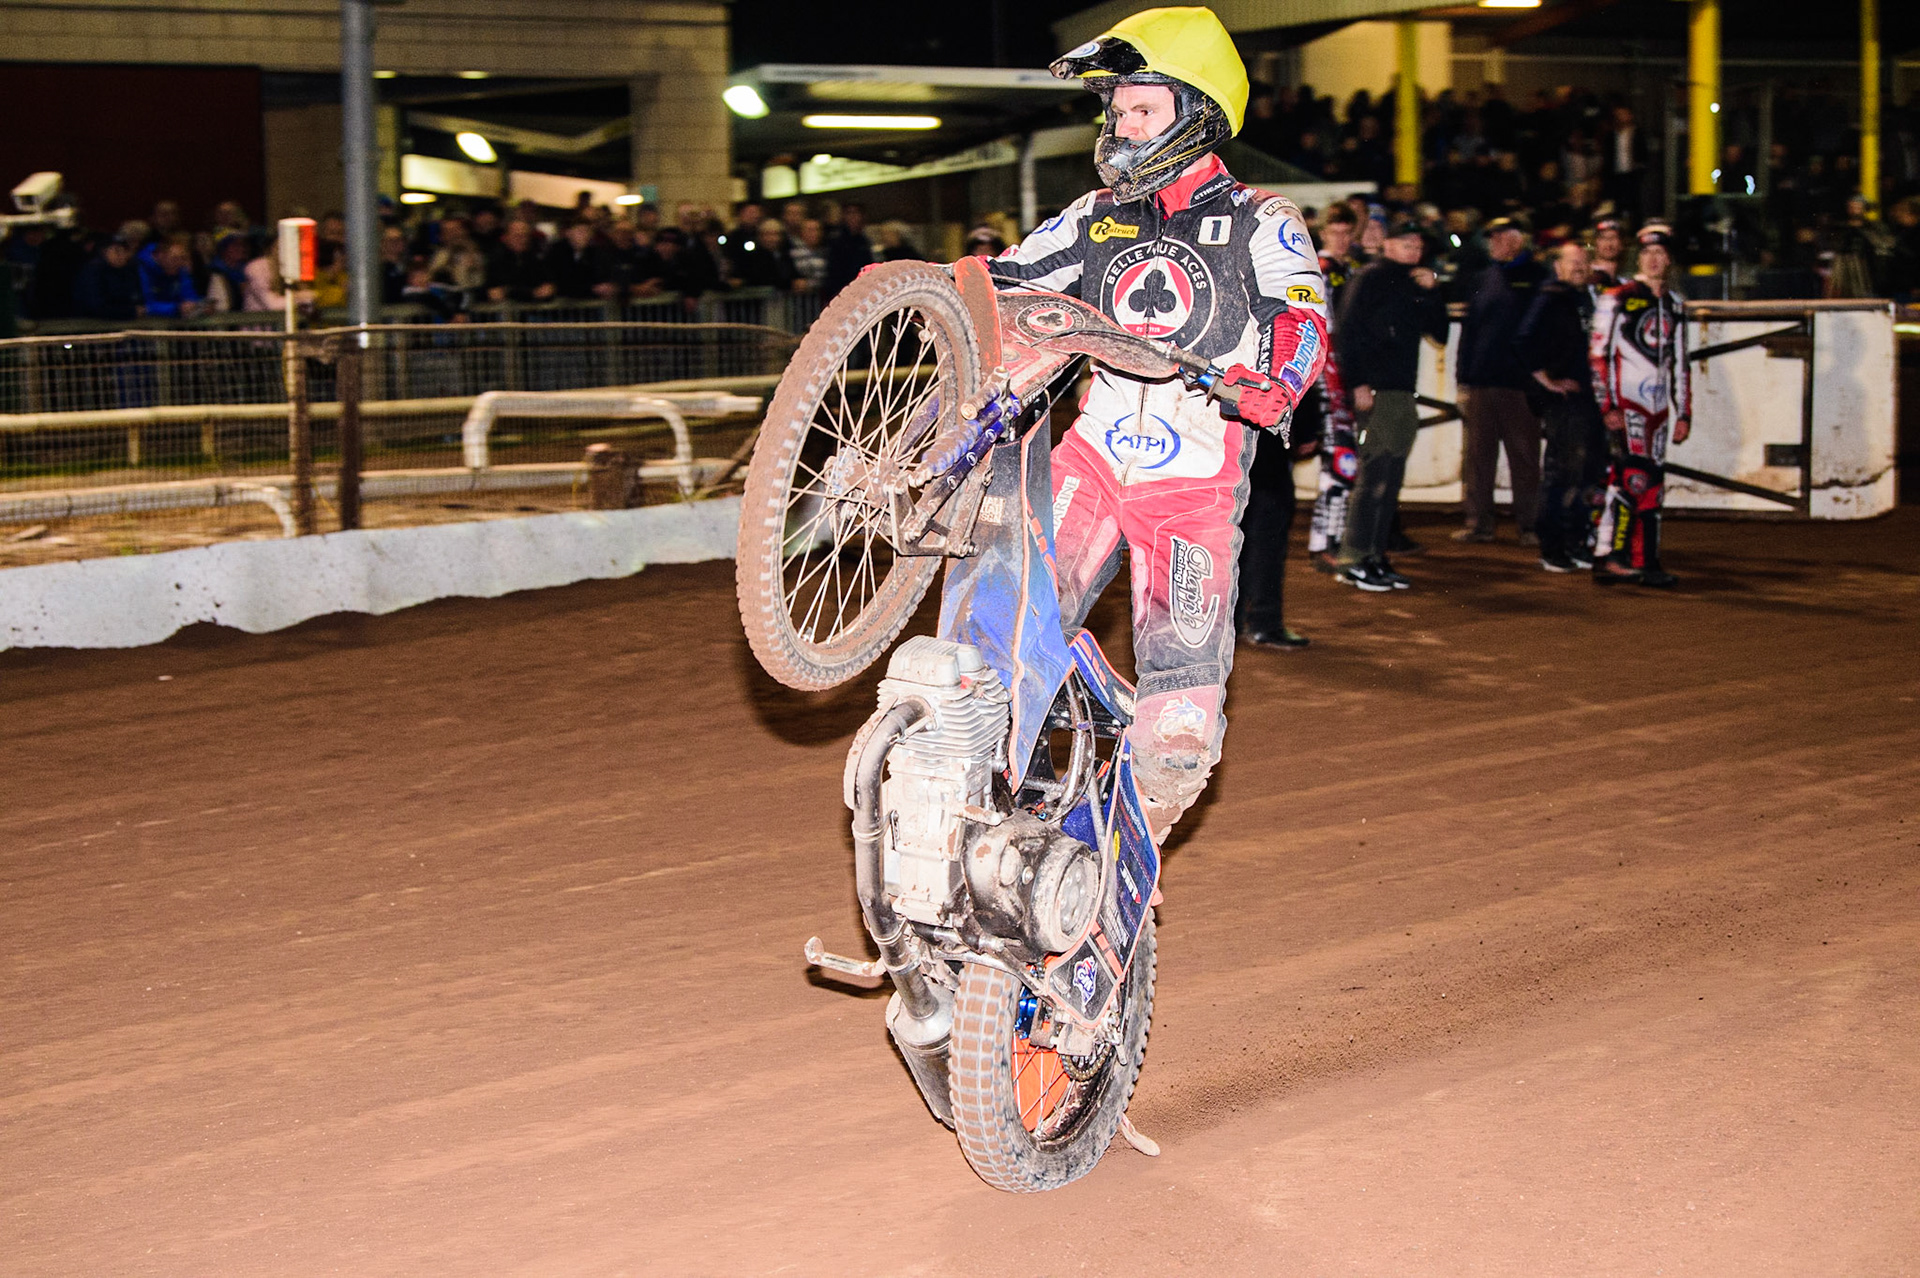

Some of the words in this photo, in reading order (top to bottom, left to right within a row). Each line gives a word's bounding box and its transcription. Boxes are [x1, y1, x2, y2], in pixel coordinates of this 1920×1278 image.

[1211, 219, 1223, 241] 1
[1106, 249, 1144, 285] BELLE
[1180, 254, 1207, 289] ACES
[1289, 319, 1318, 374] burnside
[1116, 434, 1166, 454] ATPI
[1053, 476, 1077, 528] ARINE
[1174, 541, 1188, 584] Racing
